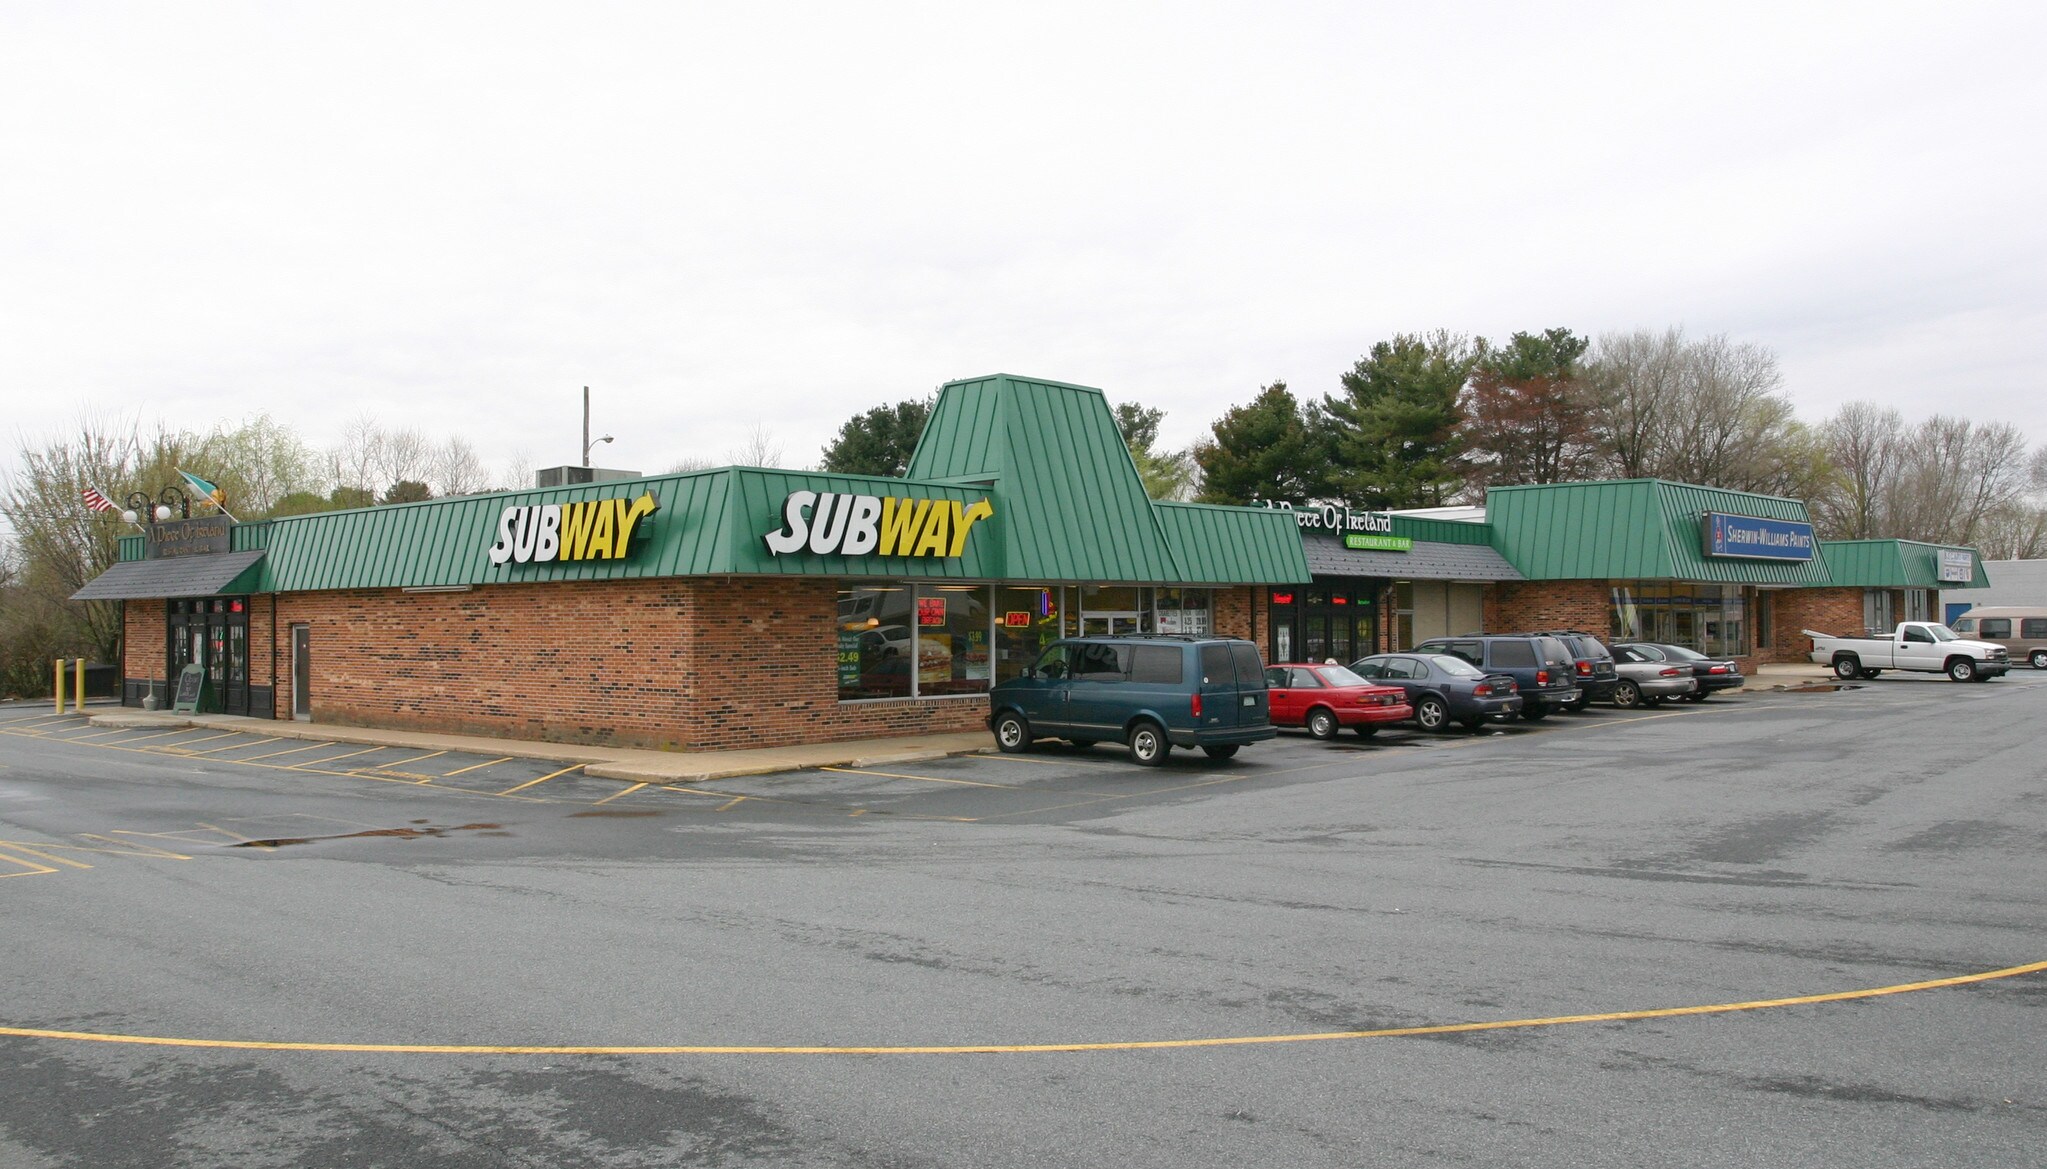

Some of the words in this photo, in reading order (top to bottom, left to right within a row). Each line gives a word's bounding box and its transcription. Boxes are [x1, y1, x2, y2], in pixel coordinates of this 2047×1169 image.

[489, 491, 655, 565] SUBWAY
[765, 490, 994, 556] SUBWAY
[1324, 505, 1343, 535] Of
[1345, 507, 1391, 532] Ireland
[1350, 537, 1391, 547] RESTAURANT
[1398, 539, 1410, 548] BAR
[1727, 525, 1789, 547] SHERWIN-WILLIAMS
[1790, 531, 1810, 548] PAINTS
[1008, 612, 1028, 626] OPEN
